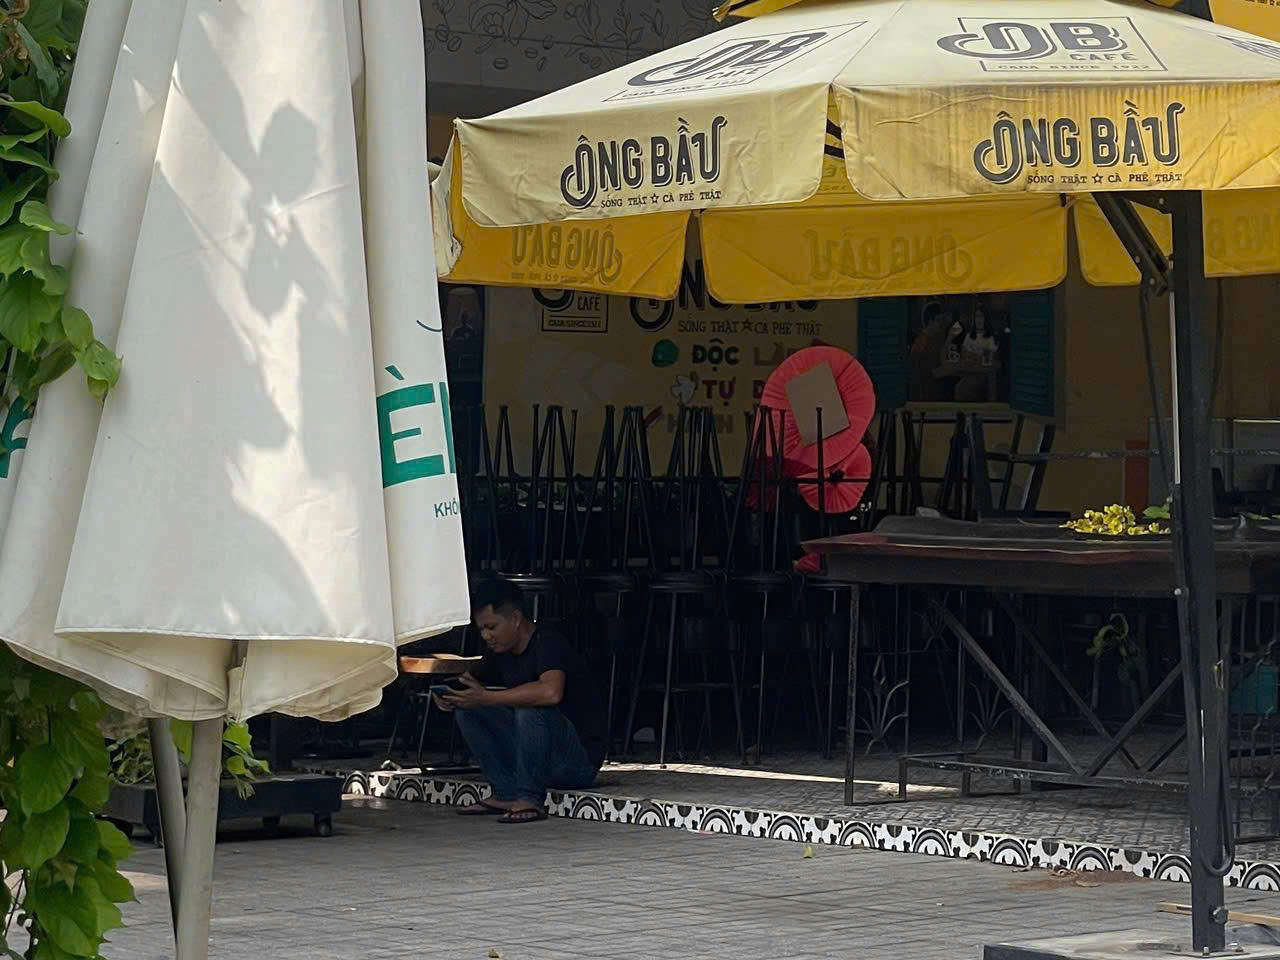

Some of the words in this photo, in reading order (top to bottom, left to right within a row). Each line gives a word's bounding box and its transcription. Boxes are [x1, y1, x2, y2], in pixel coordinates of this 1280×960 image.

[560, 134, 644, 209] ÔNG
[651, 116, 727, 187] BẦU
[973, 110, 1081, 184] ÔNG
[1090, 100, 1185, 167] BẦU
[663, 192, 674, 203] CÀ
[1027, 170, 1054, 184] SỐNG
[1108, 173, 1121, 183] CÀ
[1129, 173, 1148, 183] PHÊ
[702, 376, 736, 406] TỰ
[376, 364, 458, 488] È
